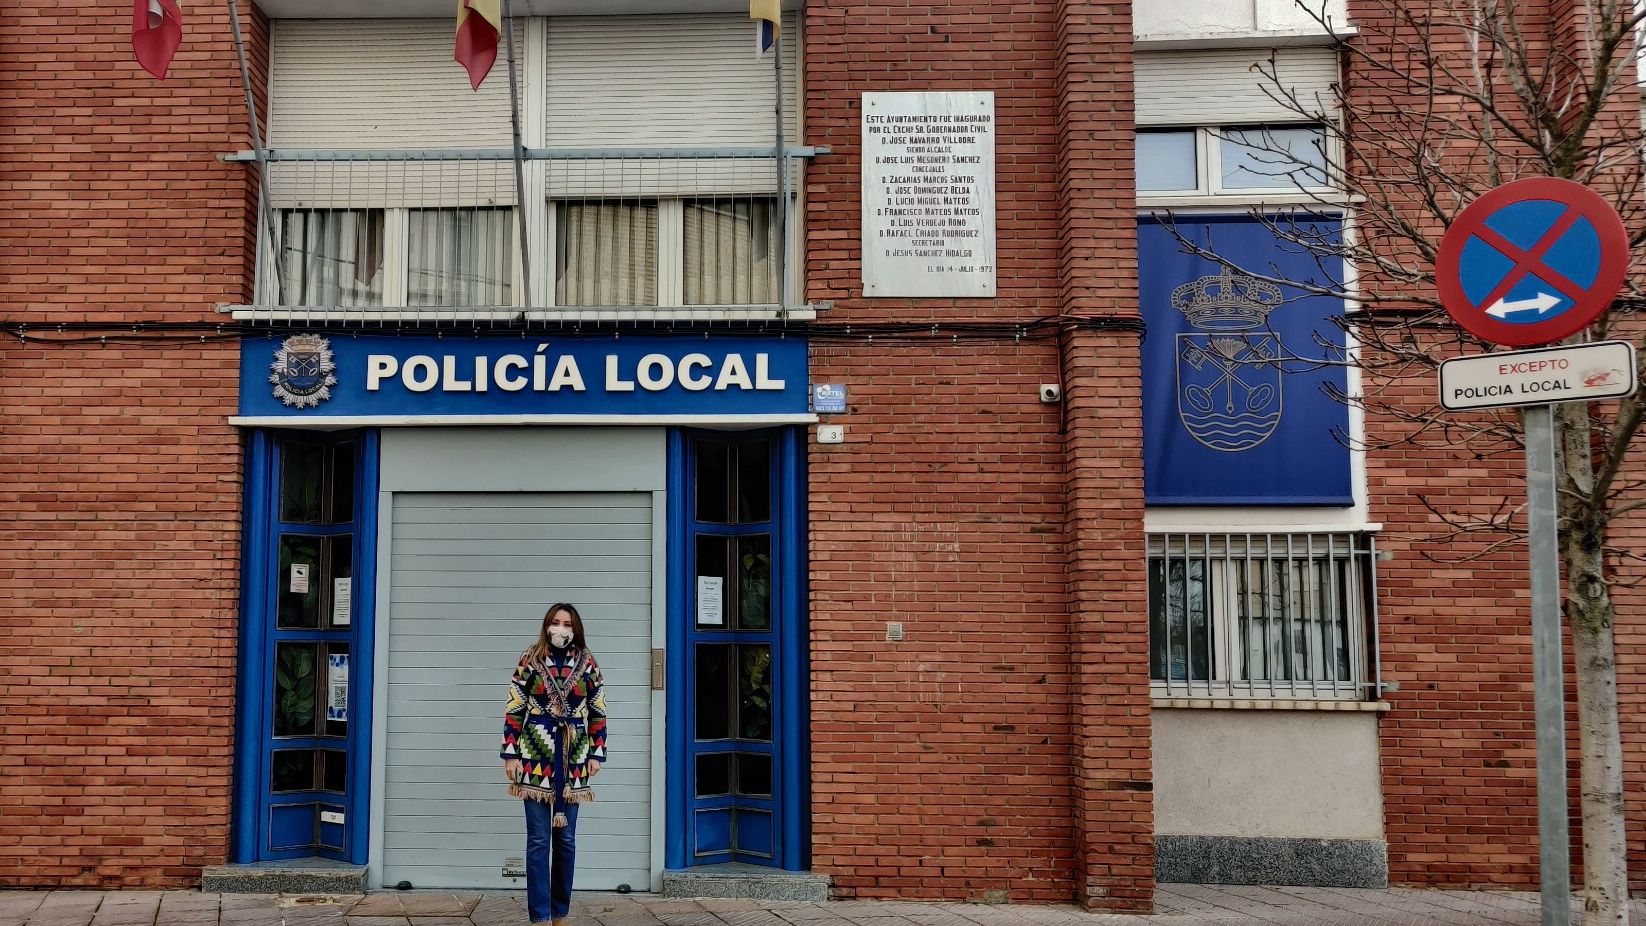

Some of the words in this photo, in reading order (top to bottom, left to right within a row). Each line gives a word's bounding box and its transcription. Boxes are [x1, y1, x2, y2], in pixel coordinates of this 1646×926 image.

[866, 114, 884, 124] ESTE
[887, 114, 937, 124] AYUNTAMIENTO
[940, 114, 952, 124] FUE
[869, 124, 881, 134] POR
[883, 124, 891, 134] EL
[927, 124, 969, 134] GOBERNADOR
[971, 124, 988, 134] CIVIL
[882, 136, 888, 145] D.
[890, 136, 907, 145] JOSE
[910, 136, 940, 145] NAVARRO
[907, 146, 926, 154] SIENDO
[927, 146, 952, 154] ALCALDE
[882, 155, 898, 164] JOSE
[900, 155, 915, 164] LUIS
[917, 155, 950, 164] MESONERO
[952, 155, 981, 164] SANCHEZ
[912, 165, 945, 173] CONCEJALES
[890, 175, 921, 184] ZACARIAS
[923, 175, 948, 184] MARCOS
[951, 175, 975, 184] SANTOS
[895, 186, 911, 195] JOSE
[914, 186, 948, 195] DOMINGUEZ
[888, 196, 894, 206] D.
[896, 196, 915, 206] LUCIO
[918, 196, 941, 206] MIGUEL
[944, 196, 970, 206] MATEOS
[885, 207, 923, 216] FRANCISCO
[925, 207, 952, 216] MATEOS
[954, 207, 980, 216] MATEOS
[899, 218, 914, 227] LUIS
[916, 218, 946, 227] VERDEJO
[887, 228, 912, 238] RAFAEL
[916, 228, 940, 238] CRIADO
[942, 228, 979, 238] RODRIGUEZ
[912, 239, 945, 247] SECRETARIO
[893, 249, 913, 257] JESUS
[915, 249, 943, 257] SANCHEZ
[946, 249, 973, 257] HIDALGO
[367, 344, 586, 392] POLICÍA
[606, 353, 786, 392] LOCAL
[1499, 358, 1569, 375] EXCEPTO
[305, 381, 323, 394] LOCAL
[1454, 384, 1513, 399] POLICIA
[1521, 378, 1572, 394] LOCAL
[831, 431, 837, 440] 3
